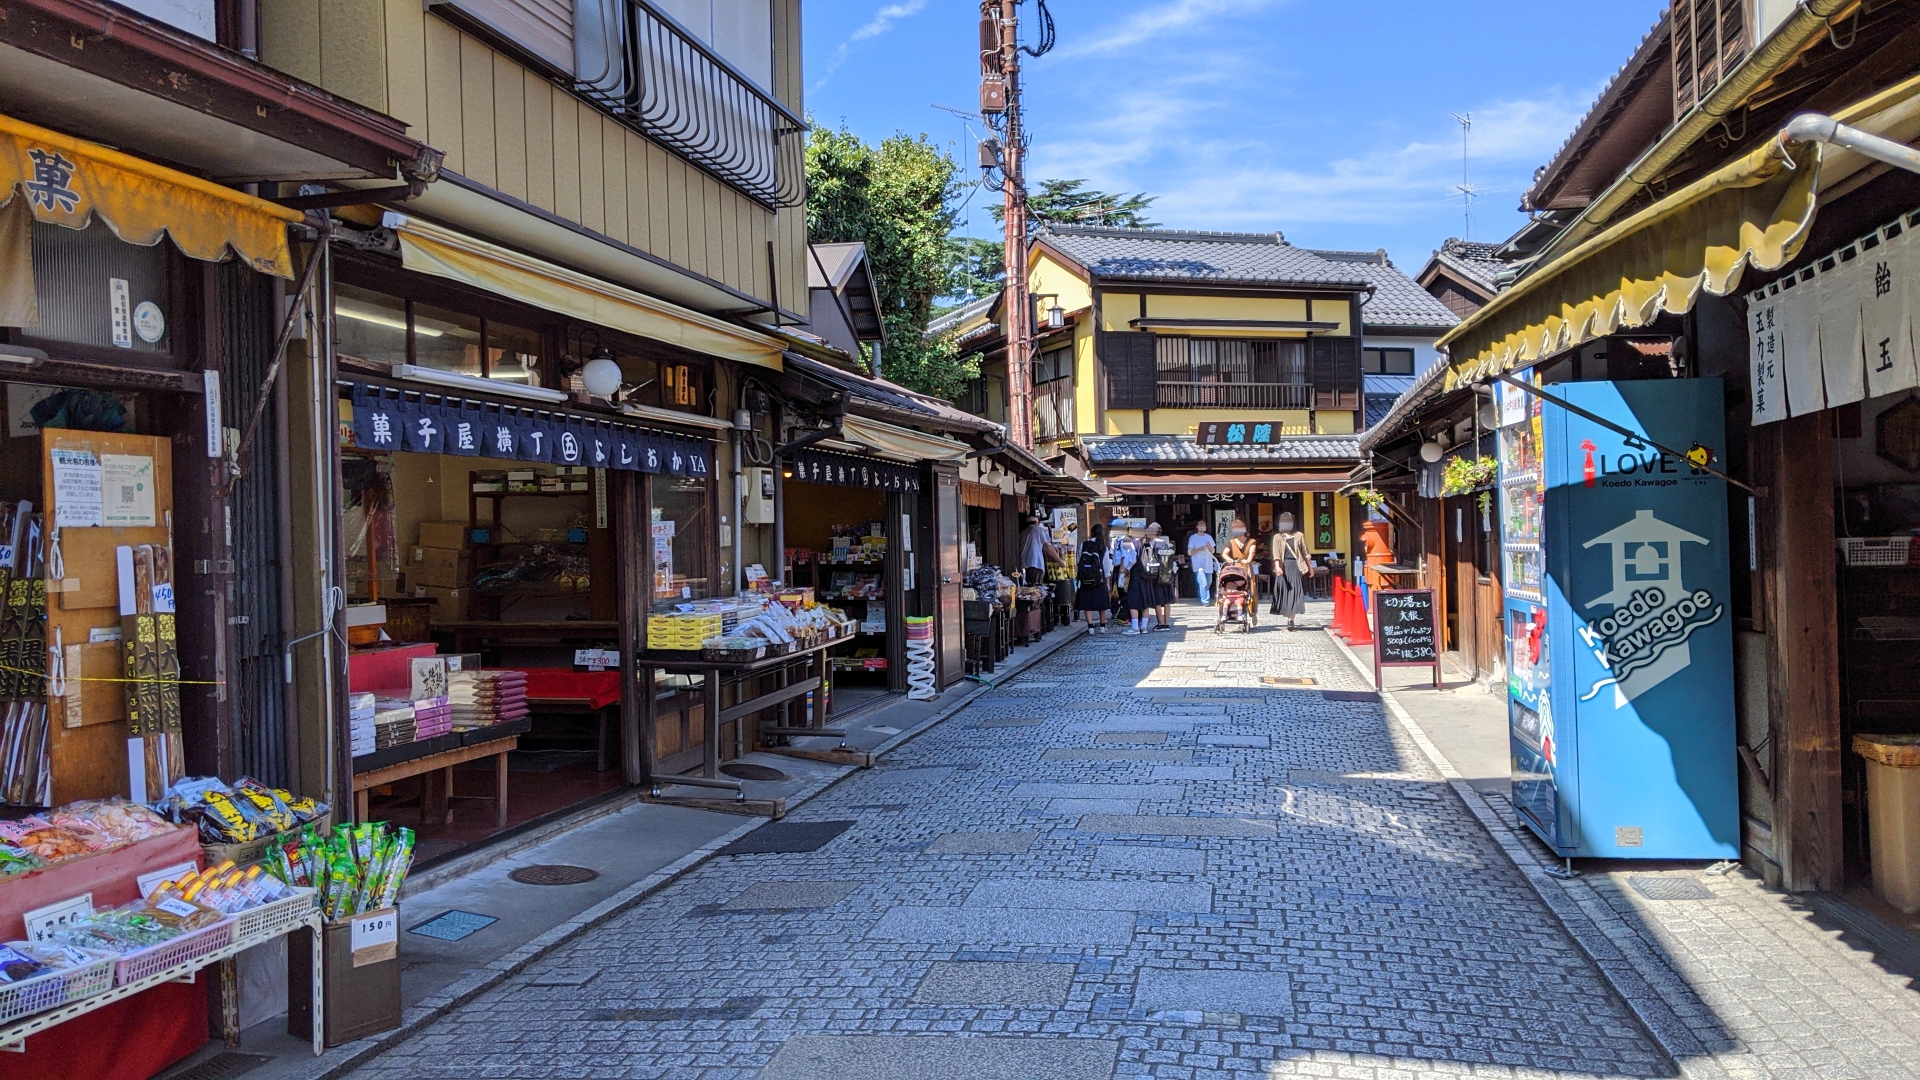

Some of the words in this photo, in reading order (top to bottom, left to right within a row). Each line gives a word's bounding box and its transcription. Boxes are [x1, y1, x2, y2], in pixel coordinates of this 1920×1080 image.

[27, 149, 80, 213] 菓
[1876, 261, 1893, 373] 飴玉
[1766, 306, 1776, 379] 製造元
[1755, 311, 1766, 414] 玉力製菓
[1226, 423, 1273, 444] 松陸
[59, 456, 102, 467] 観光客の皆様へ
[1600, 452, 1678, 476] LOVE
[1601, 479, 1632, 488] Koedo
[1634, 478, 1678, 488] Kawagoe
[1319, 512, 1332, 544] あめ
[155, 587, 173, 600] 450
[1385, 595, 1430, 608] 切り落とし
[1399, 610, 1424, 622] 大根
[1578, 589, 1664, 648] Koedo
[1593, 590, 1712, 670] Kawagoe
[362, 920, 392, 934] 150円
